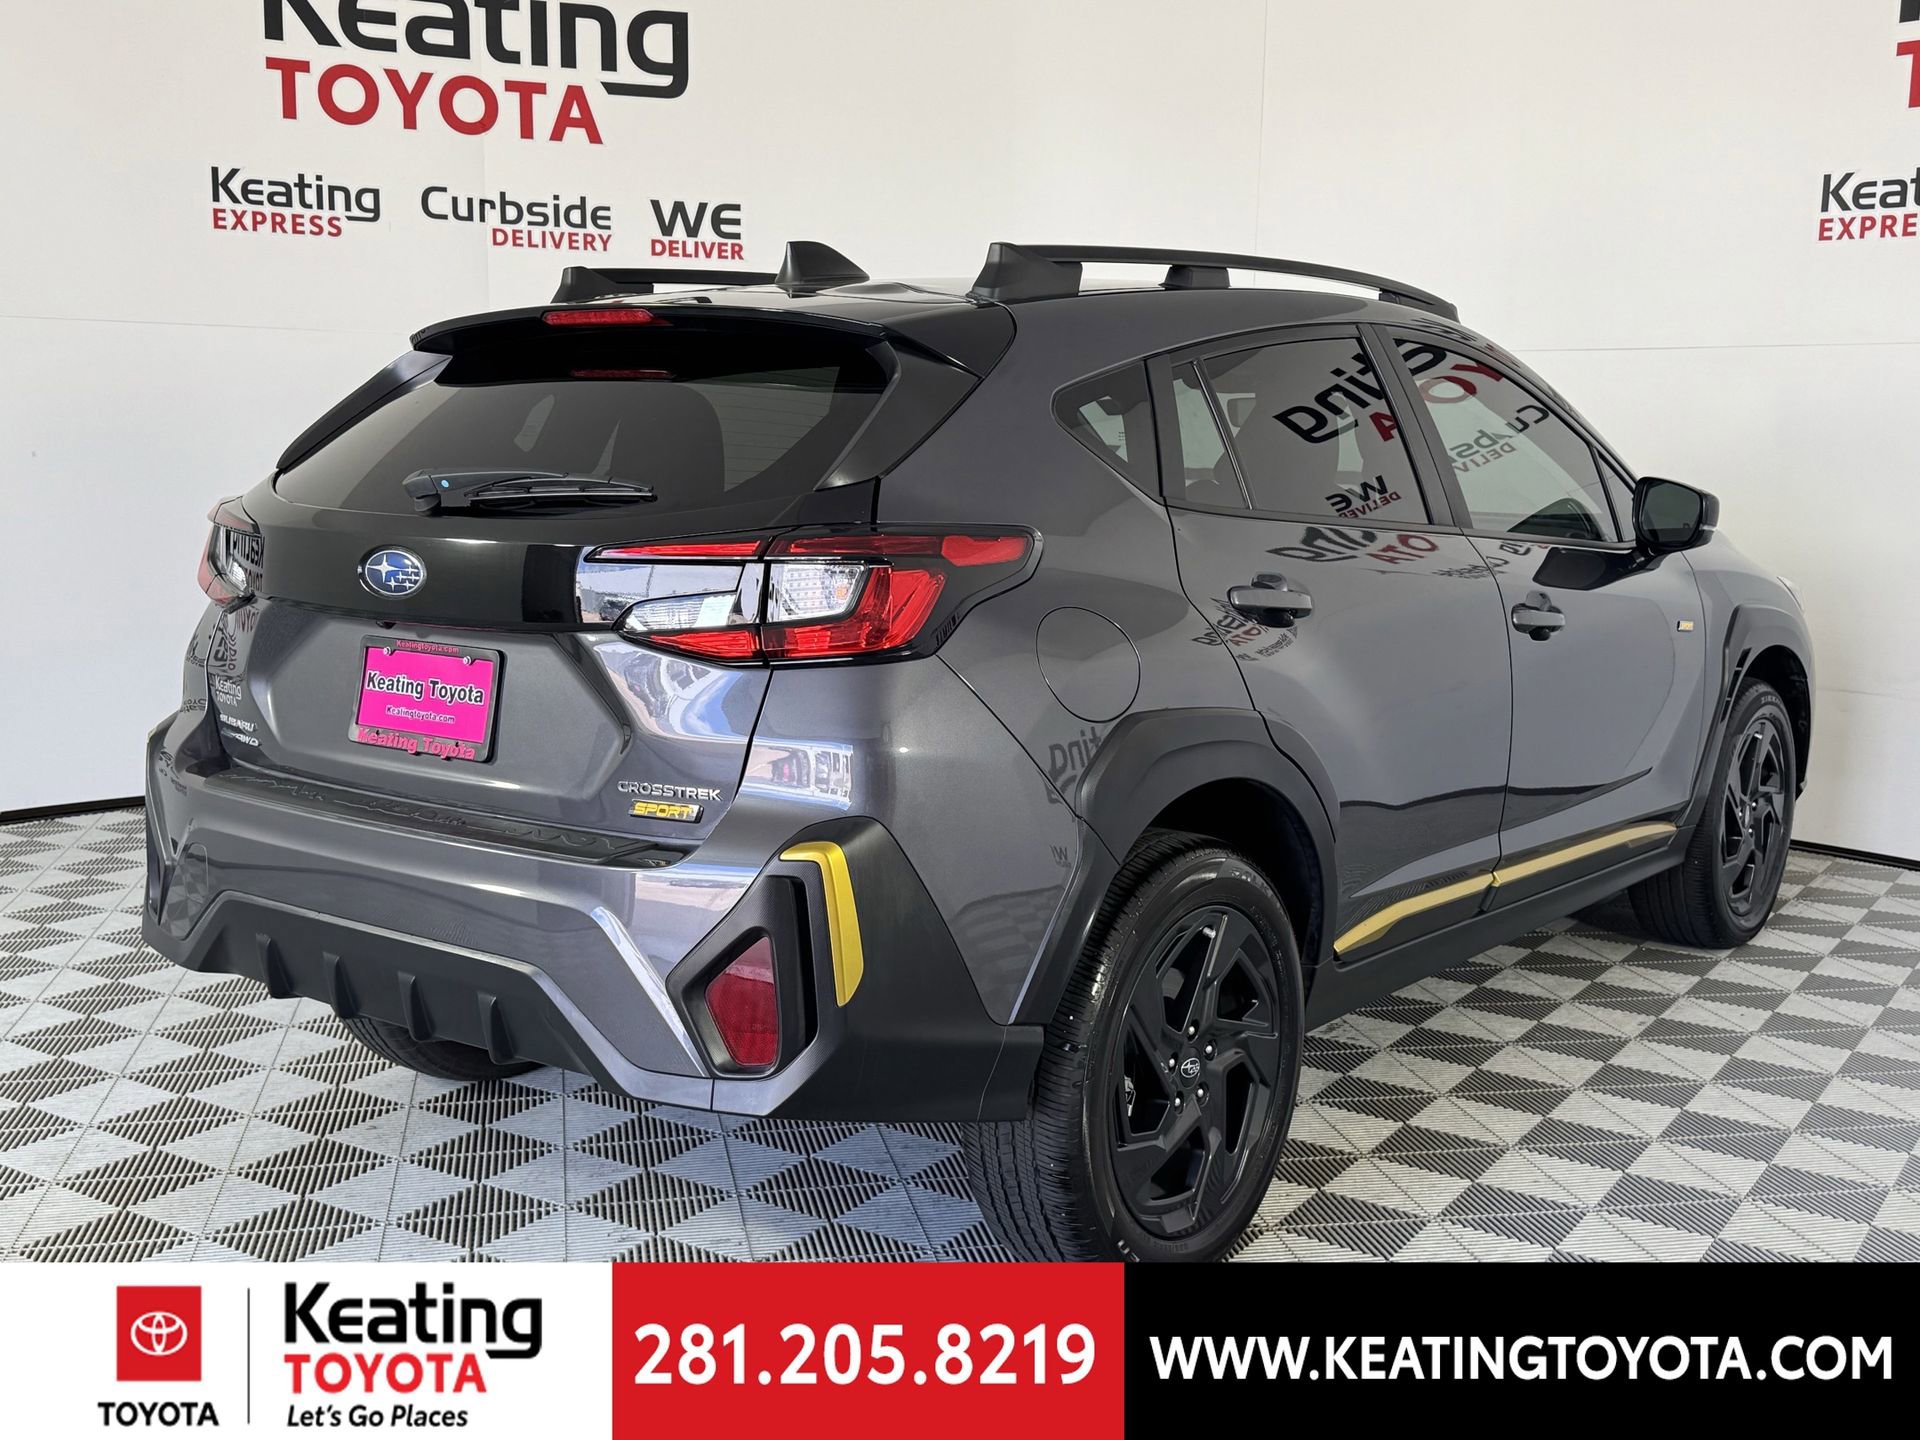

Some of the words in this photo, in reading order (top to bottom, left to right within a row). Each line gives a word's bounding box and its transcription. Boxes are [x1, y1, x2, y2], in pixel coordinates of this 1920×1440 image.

[265, 56, 602, 145] TOYOTA
[211, 166, 380, 222] Keating
[422, 186, 611, 230] Curbside
[213, 208, 342, 237] EXPRESS
[650, 199, 741, 239] WE
[492, 228, 612, 252] DELIVERY
[651, 239, 744, 260] DELIVER
[366, 671, 425, 700] Keating
[429, 679, 485, 706] Toyota
[219, 713, 255, 732] SUBARU
[357, 727, 418, 753] Keating
[423, 736, 476, 761] Toyota
[617, 780, 722, 801] CROSSTREK
[633, 801, 692, 820] SPORT
